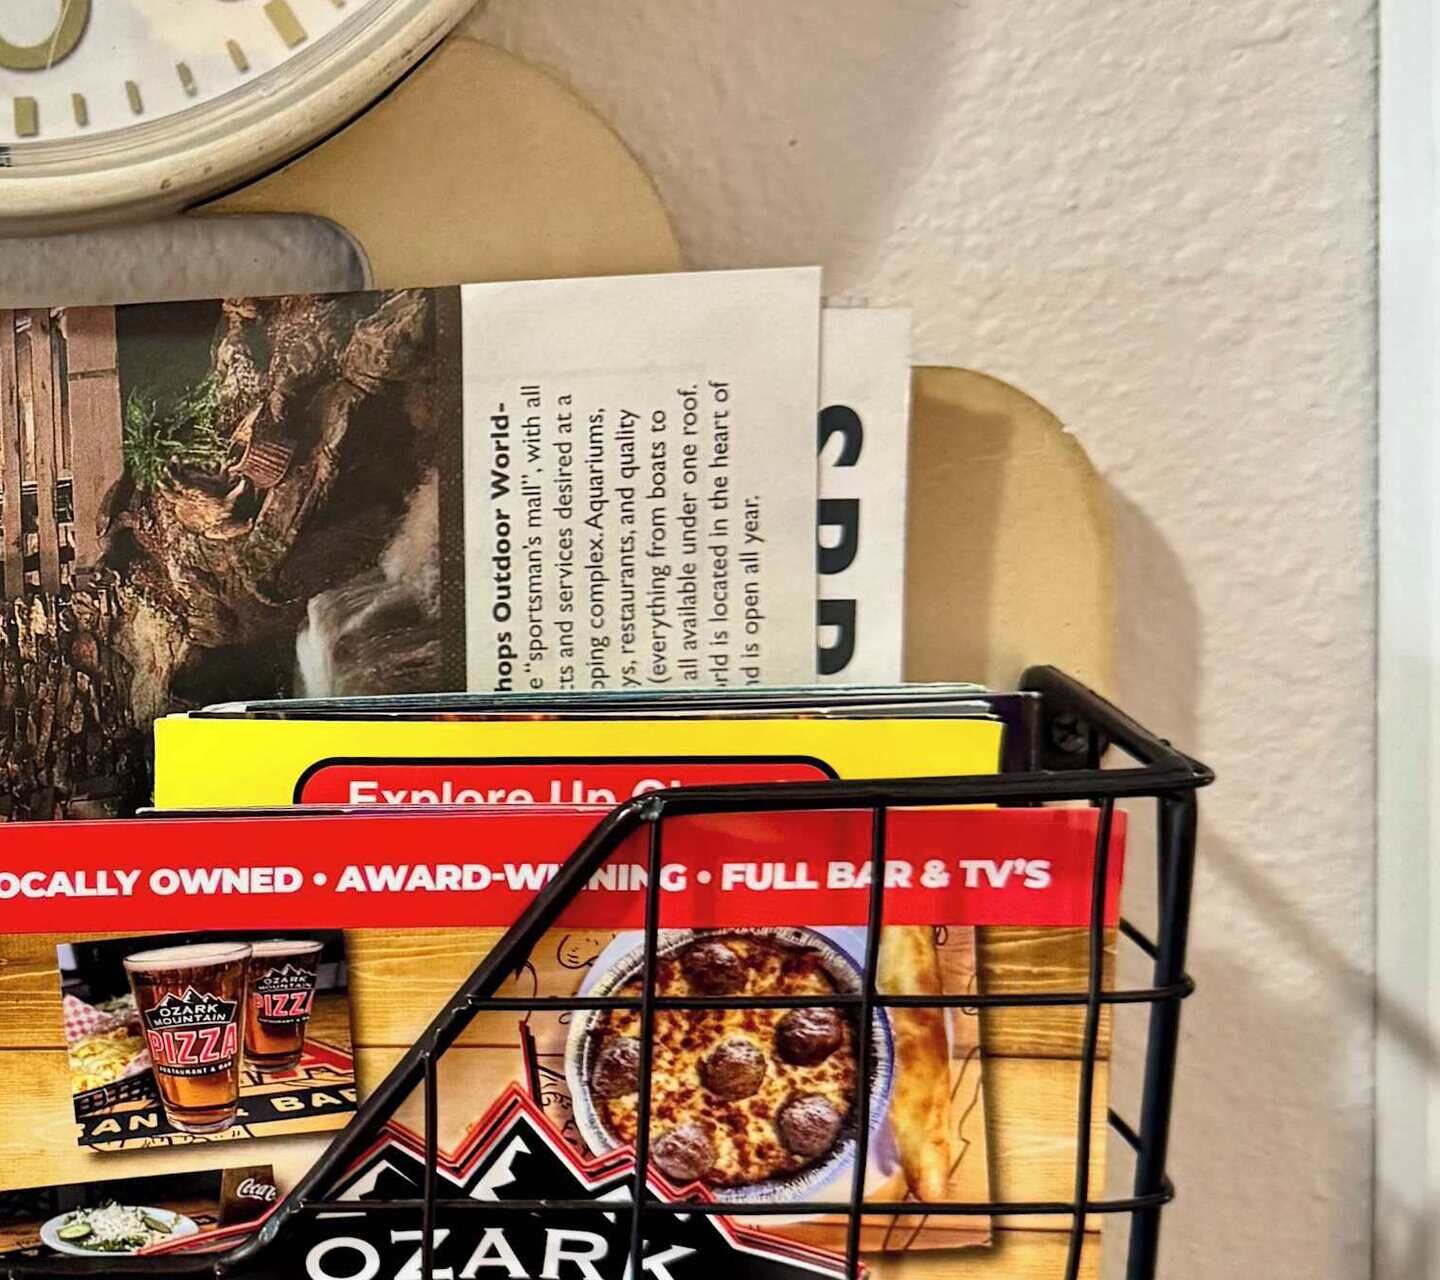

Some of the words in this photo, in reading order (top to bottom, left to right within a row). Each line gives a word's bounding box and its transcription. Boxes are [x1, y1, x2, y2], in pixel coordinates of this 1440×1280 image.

[519, 385, 541, 408] all
[557, 394, 572, 406] a
[677, 384, 698, 436] roof.
[708, 379, 729, 403] of
[520, 416, 541, 463] with
[557, 412, 572, 434] at
[614, 408, 641, 480] quality
[651, 409, 667, 433] to
[708, 411, 729, 469] heart
[490, 402, 511, 500] World-
[583, 408, 610, 530] Aquariums,
[645, 441, 667, 500] boats
[682, 444, 698, 485] one
[552, 441, 573, 520] desired
[707, 476, 729, 511] the
[614, 487, 635, 525] and
[676, 492, 698, 555] under
[708, 518, 729, 537] in
[744, 495, 765, 544] year.
[645, 507, 666, 558] from
[491, 507, 512, 623] Outdoor
[554, 527, 574, 613] services
[583, 532, 610, 630] complex.
[707, 544, 728, 622] located
[738, 551, 759, 574] all
[619, 529, 637, 654] restaurants,
[676, 562, 698, 650] available
[744, 581, 765, 635] open
[553, 620, 574, 658] and
[645, 564, 672, 684] (everything
[709, 630, 728, 646] is
[493, 631, 519, 690] hops
[677, 658, 698, 680] all
[708, 653, 729, 683] rld
[745, 642, 760, 658] is
[149, 866, 303, 896] OWNED
[335, 863, 687, 893] AWARD-WINING
[721, 861, 819, 891] FULL
[827, 860, 913, 890] BAR
[920, 859, 951, 889] &
[960, 858, 1051, 889] TV'S
[153, 1013, 227, 1027] MOUNTAIN
[159, 1003, 219, 1017] OZARK
[147, 1022, 238, 1065] PIZZA
